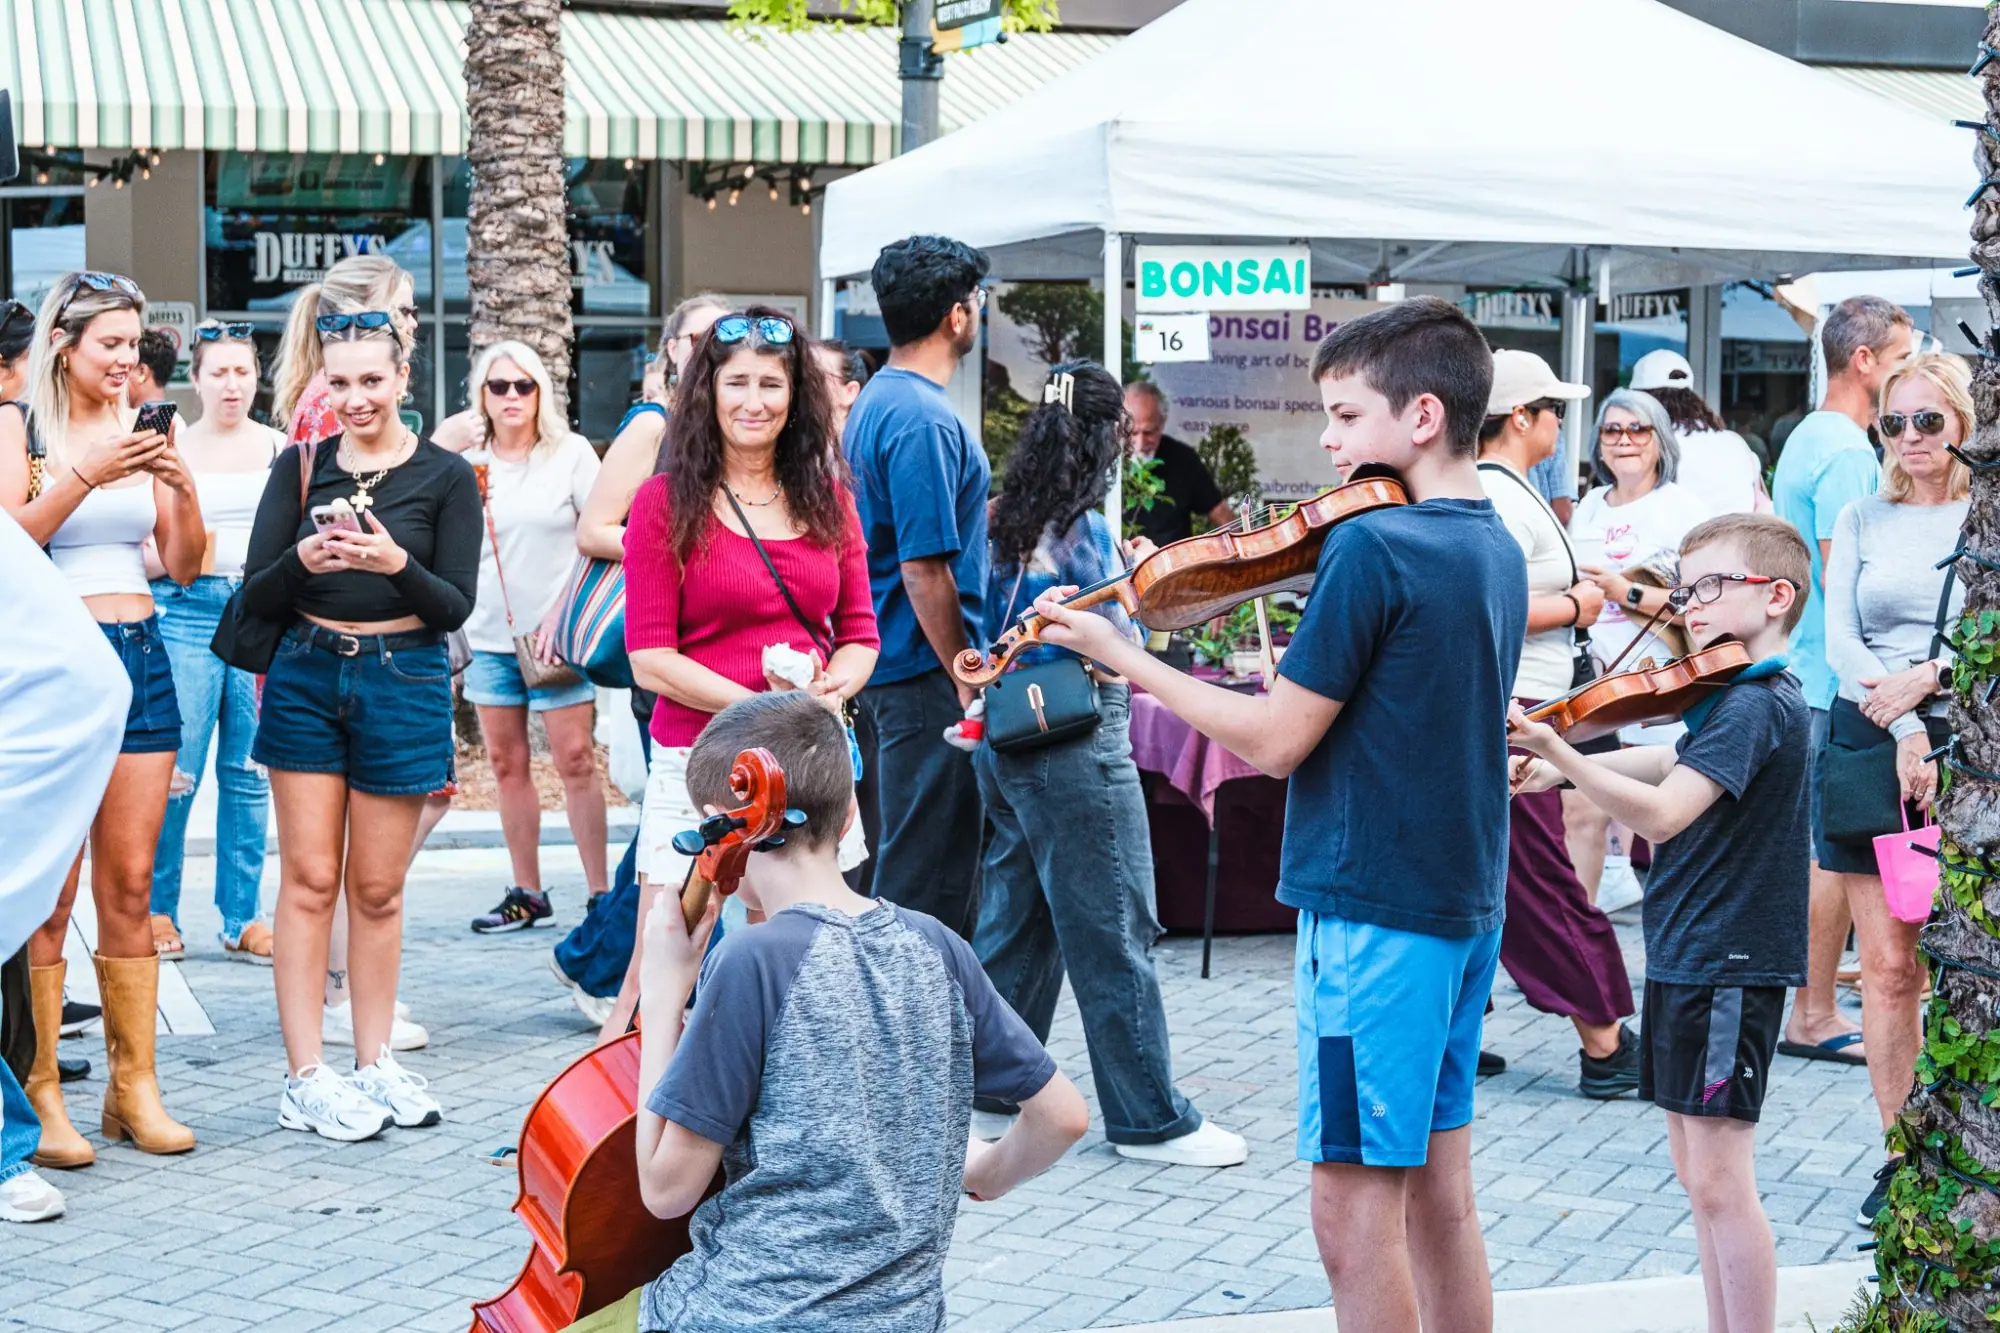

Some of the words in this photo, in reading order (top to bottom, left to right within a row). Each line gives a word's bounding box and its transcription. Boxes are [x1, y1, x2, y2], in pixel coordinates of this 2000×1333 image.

[1142, 258, 1305, 298] BONSAI
[1210, 312, 1290, 340] onsai
[1304, 315, 1337, 342] Br
[1159, 331, 1183, 351] 16
[1212, 350, 1247, 369] living
[1251, 354, 1270, 366] art
[1275, 353, 1290, 367] of
[1234, 394, 1281, 410] bonsai
[1285, 398, 1326, 415] speci
